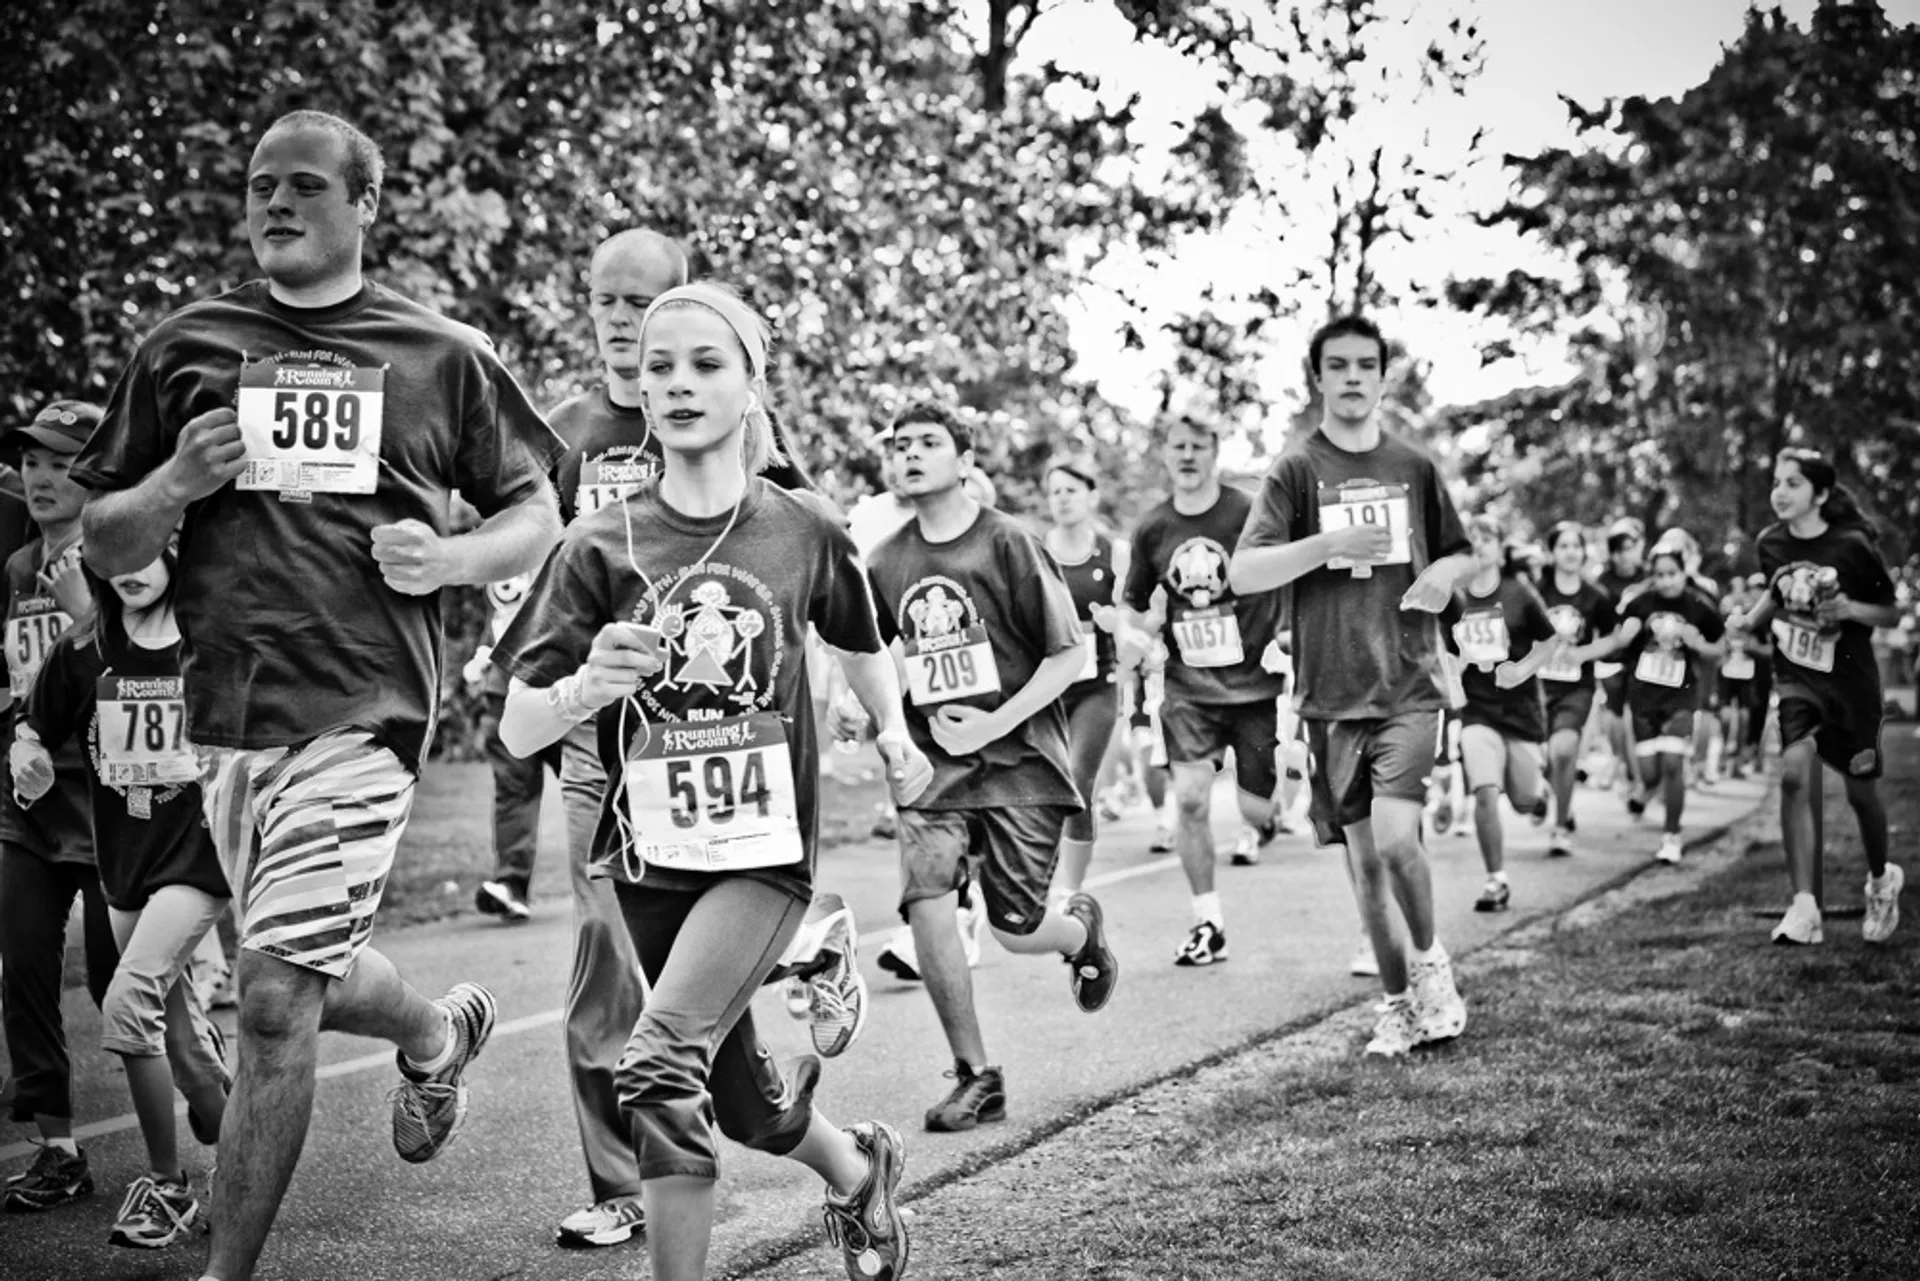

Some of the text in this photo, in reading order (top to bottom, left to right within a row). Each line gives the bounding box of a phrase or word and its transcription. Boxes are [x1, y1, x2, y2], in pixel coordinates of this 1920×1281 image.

[272, 391, 361, 451] 589
[127, 679, 175, 693] Running
[923, 649, 978, 693] 209
[122, 703, 184, 752] 787
[674, 723, 740, 746] Running
[687, 708, 725, 722] RUN
[666, 751, 772, 829] 594
